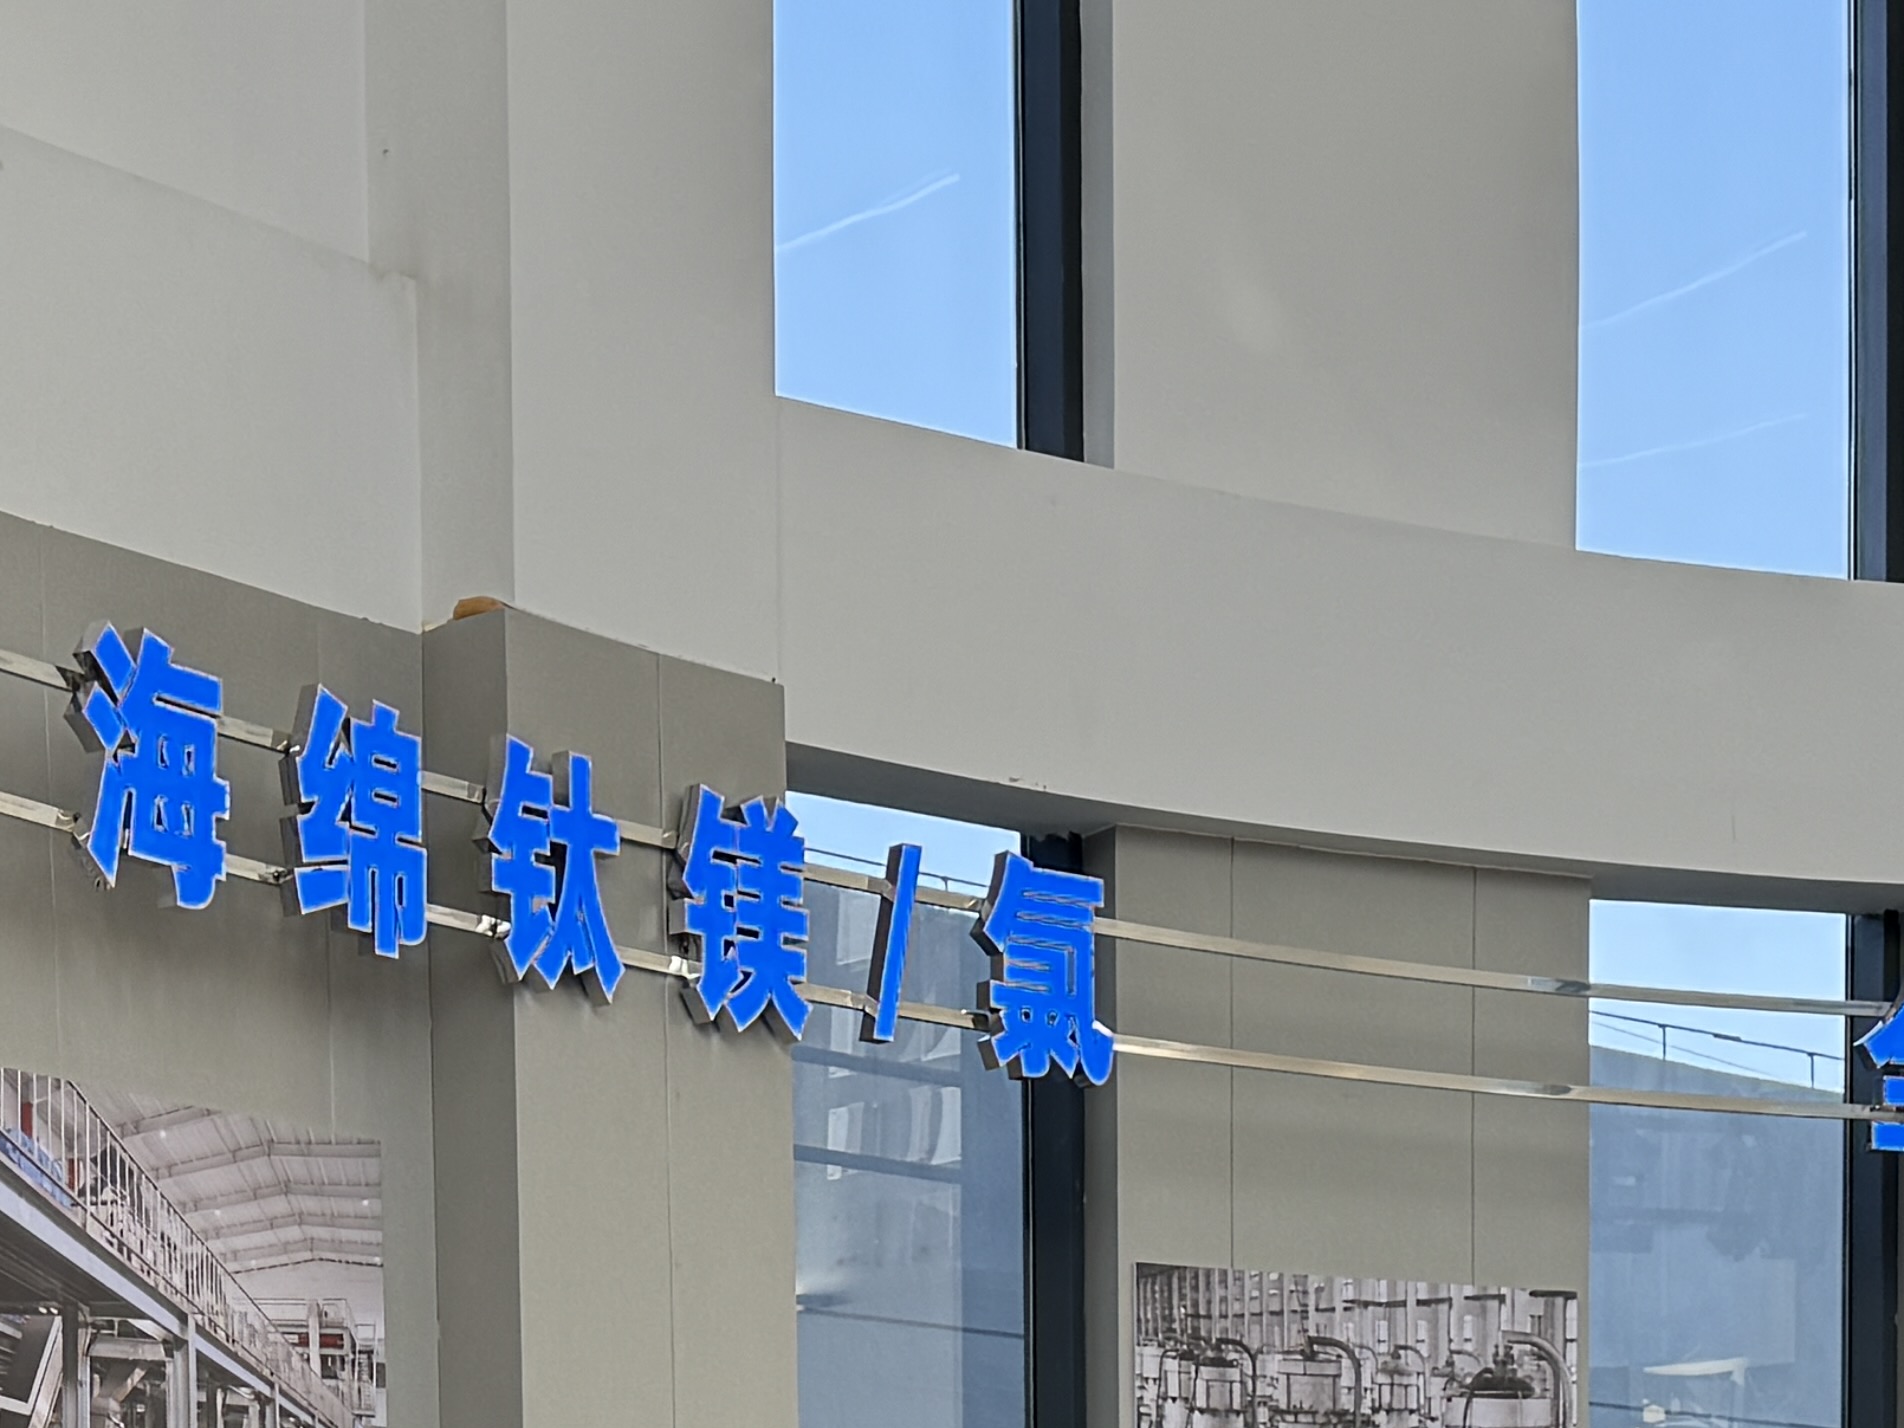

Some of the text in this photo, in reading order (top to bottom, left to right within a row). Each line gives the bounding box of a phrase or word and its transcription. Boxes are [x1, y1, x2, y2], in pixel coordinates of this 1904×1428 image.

[73, 620, 1114, 1087] 海绵钛镁/氯
